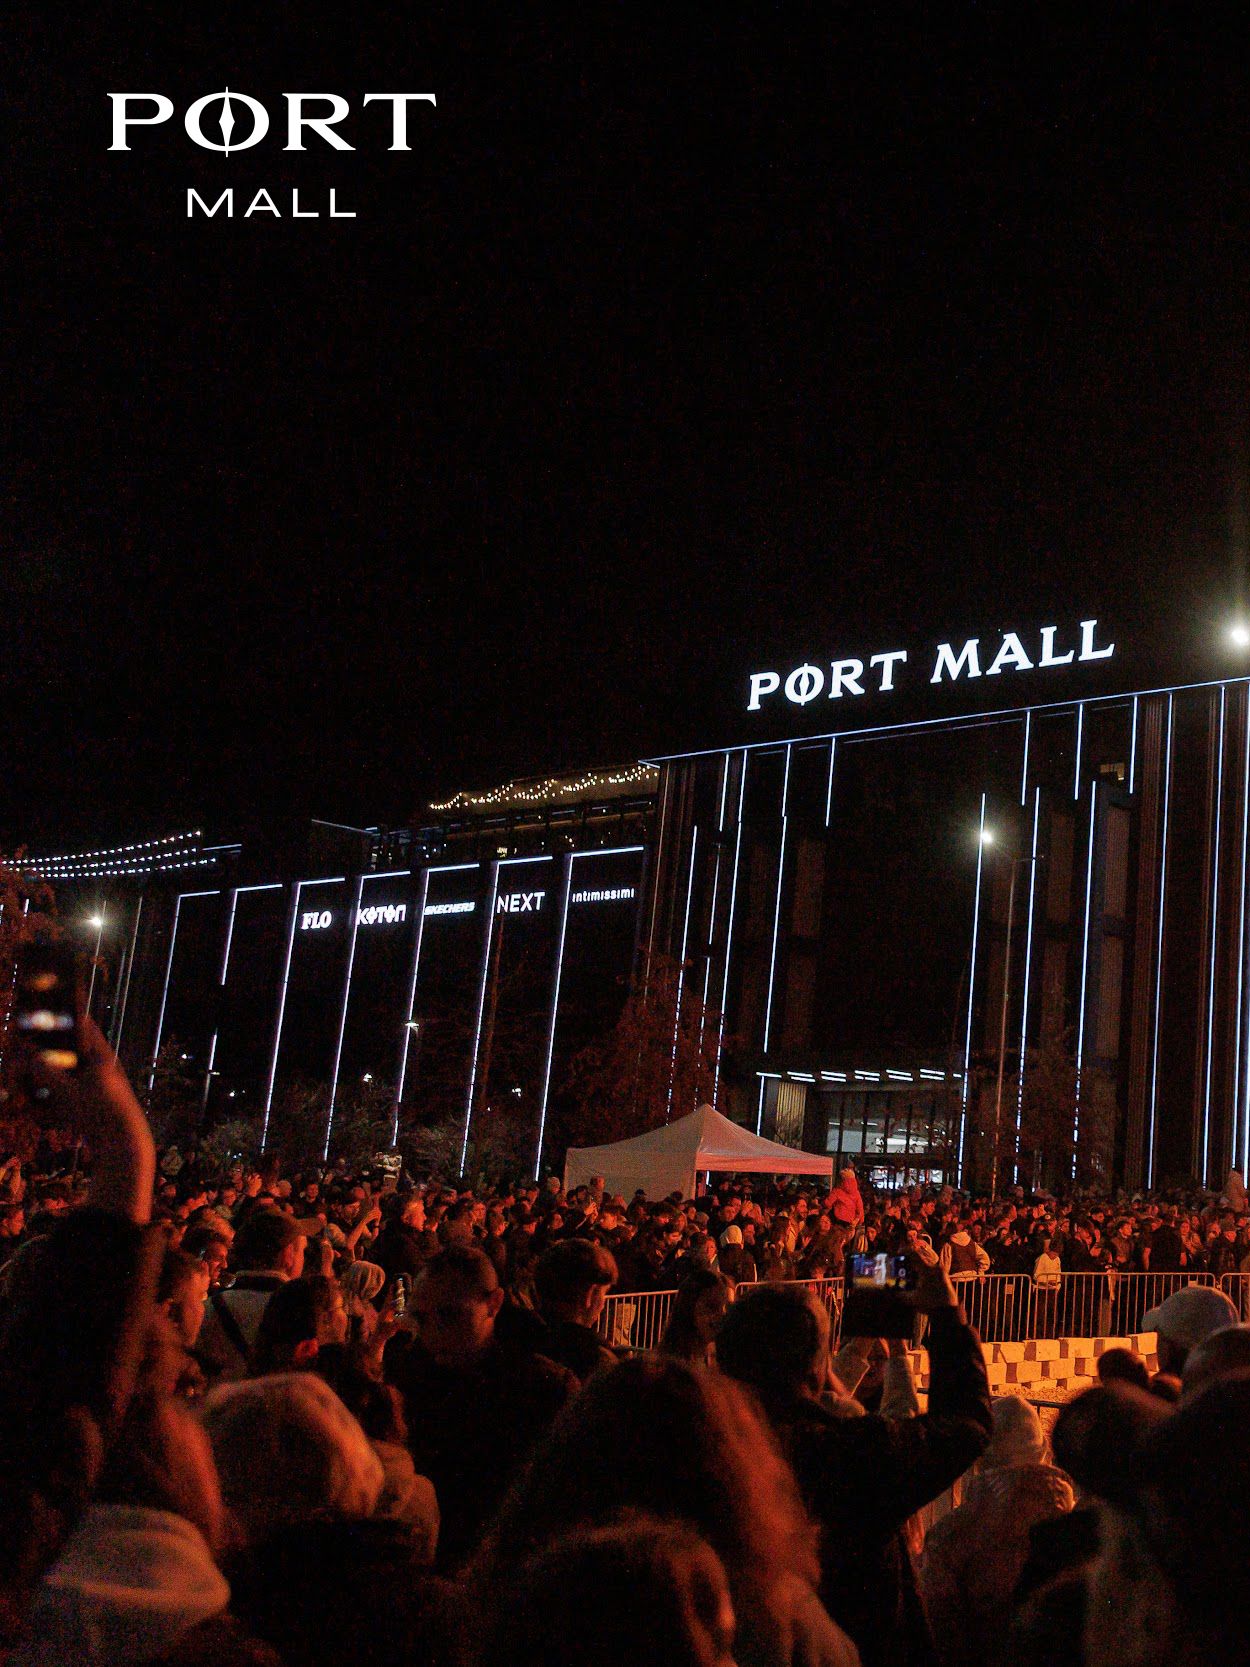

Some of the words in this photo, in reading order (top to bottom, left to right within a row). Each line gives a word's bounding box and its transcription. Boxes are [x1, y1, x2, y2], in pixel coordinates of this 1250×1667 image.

[746, 650, 908, 711] PORT
[929, 619, 1116, 684] MALL
[496, 891, 546, 914] NEXT
[571, 887, 635, 903] intimissimi
[300, 910, 333, 931] FLO
